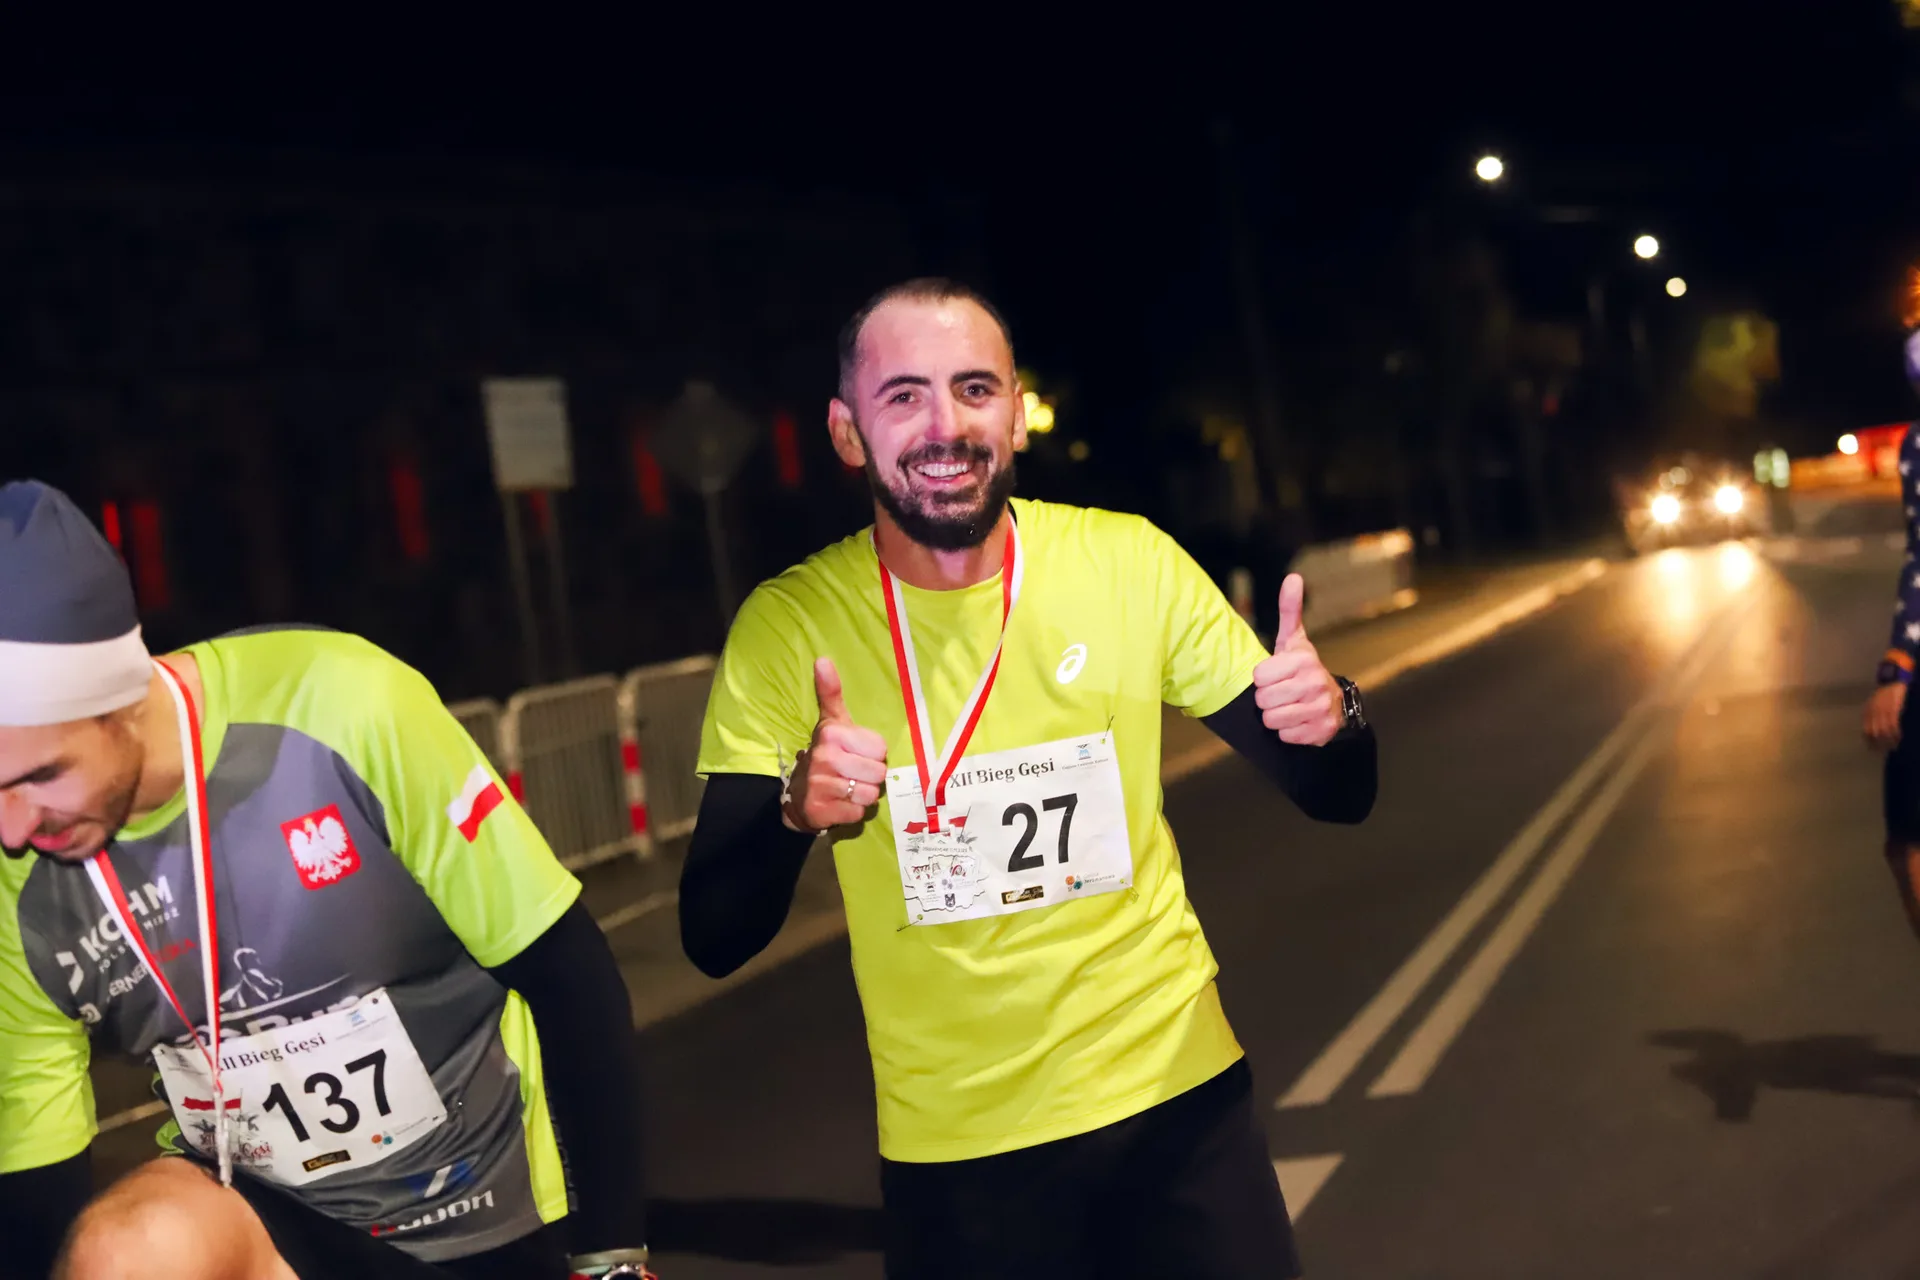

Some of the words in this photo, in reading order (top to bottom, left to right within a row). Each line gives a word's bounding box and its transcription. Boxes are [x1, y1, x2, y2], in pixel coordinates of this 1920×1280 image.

[976, 768, 1015, 784] Bieg
[1018, 758, 1055, 778] Gęsi
[1001, 793, 1078, 873] 27
[238, 1048, 284, 1067] Bieg
[284, 1032, 326, 1055] Gęsi
[262, 1048, 392, 1143] 137
